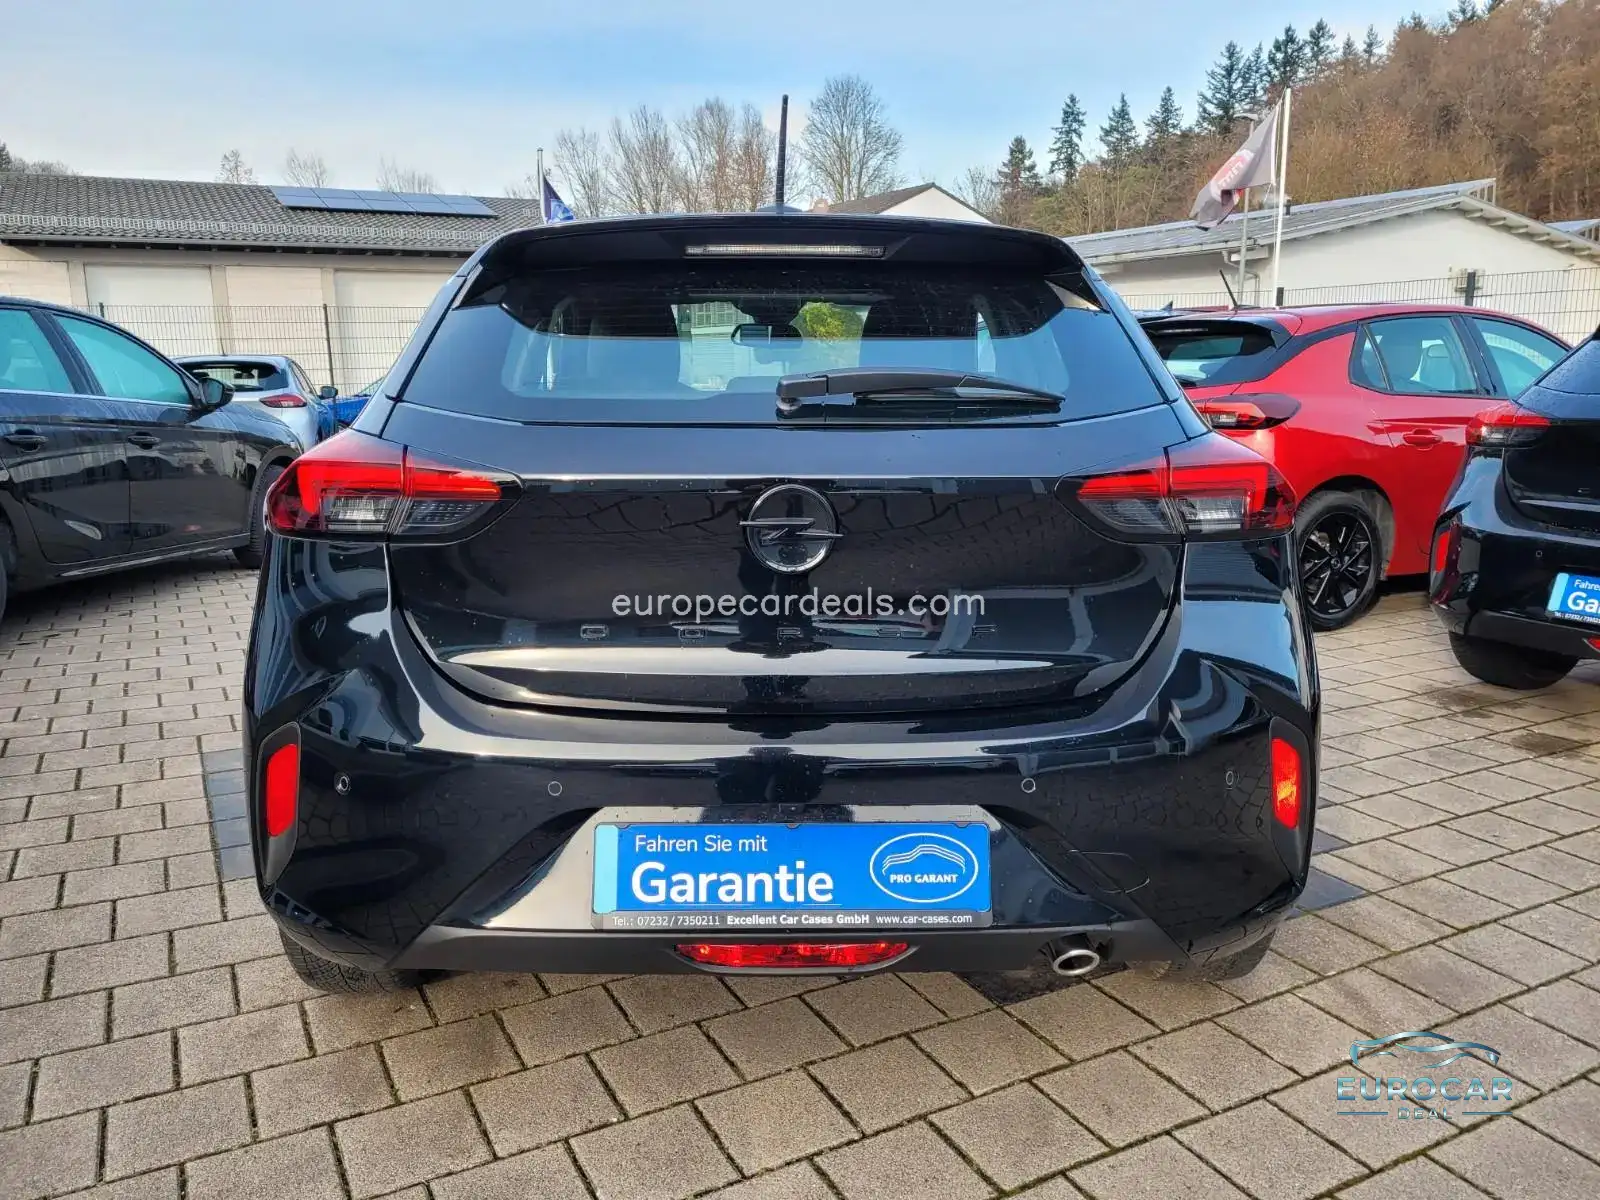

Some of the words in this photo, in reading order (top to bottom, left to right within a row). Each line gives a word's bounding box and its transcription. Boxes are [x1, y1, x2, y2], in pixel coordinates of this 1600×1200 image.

[1567, 591, 1600, 614] Ga
[634, 834, 699, 852] Fahren
[704, 834, 732, 852] Sie
[738, 834, 768, 852] mit
[631, 860, 834, 904] Garantie
[889, 874, 912, 883] PRO
[914, 874, 959, 884] GARANT
[726, 914, 777, 926] Excellent
[779, 914, 799, 925] Car
[801, 914, 833, 924] Cases
[836, 914, 870, 924] GmbH
[875, 914, 973, 924] www.car-cases.com
